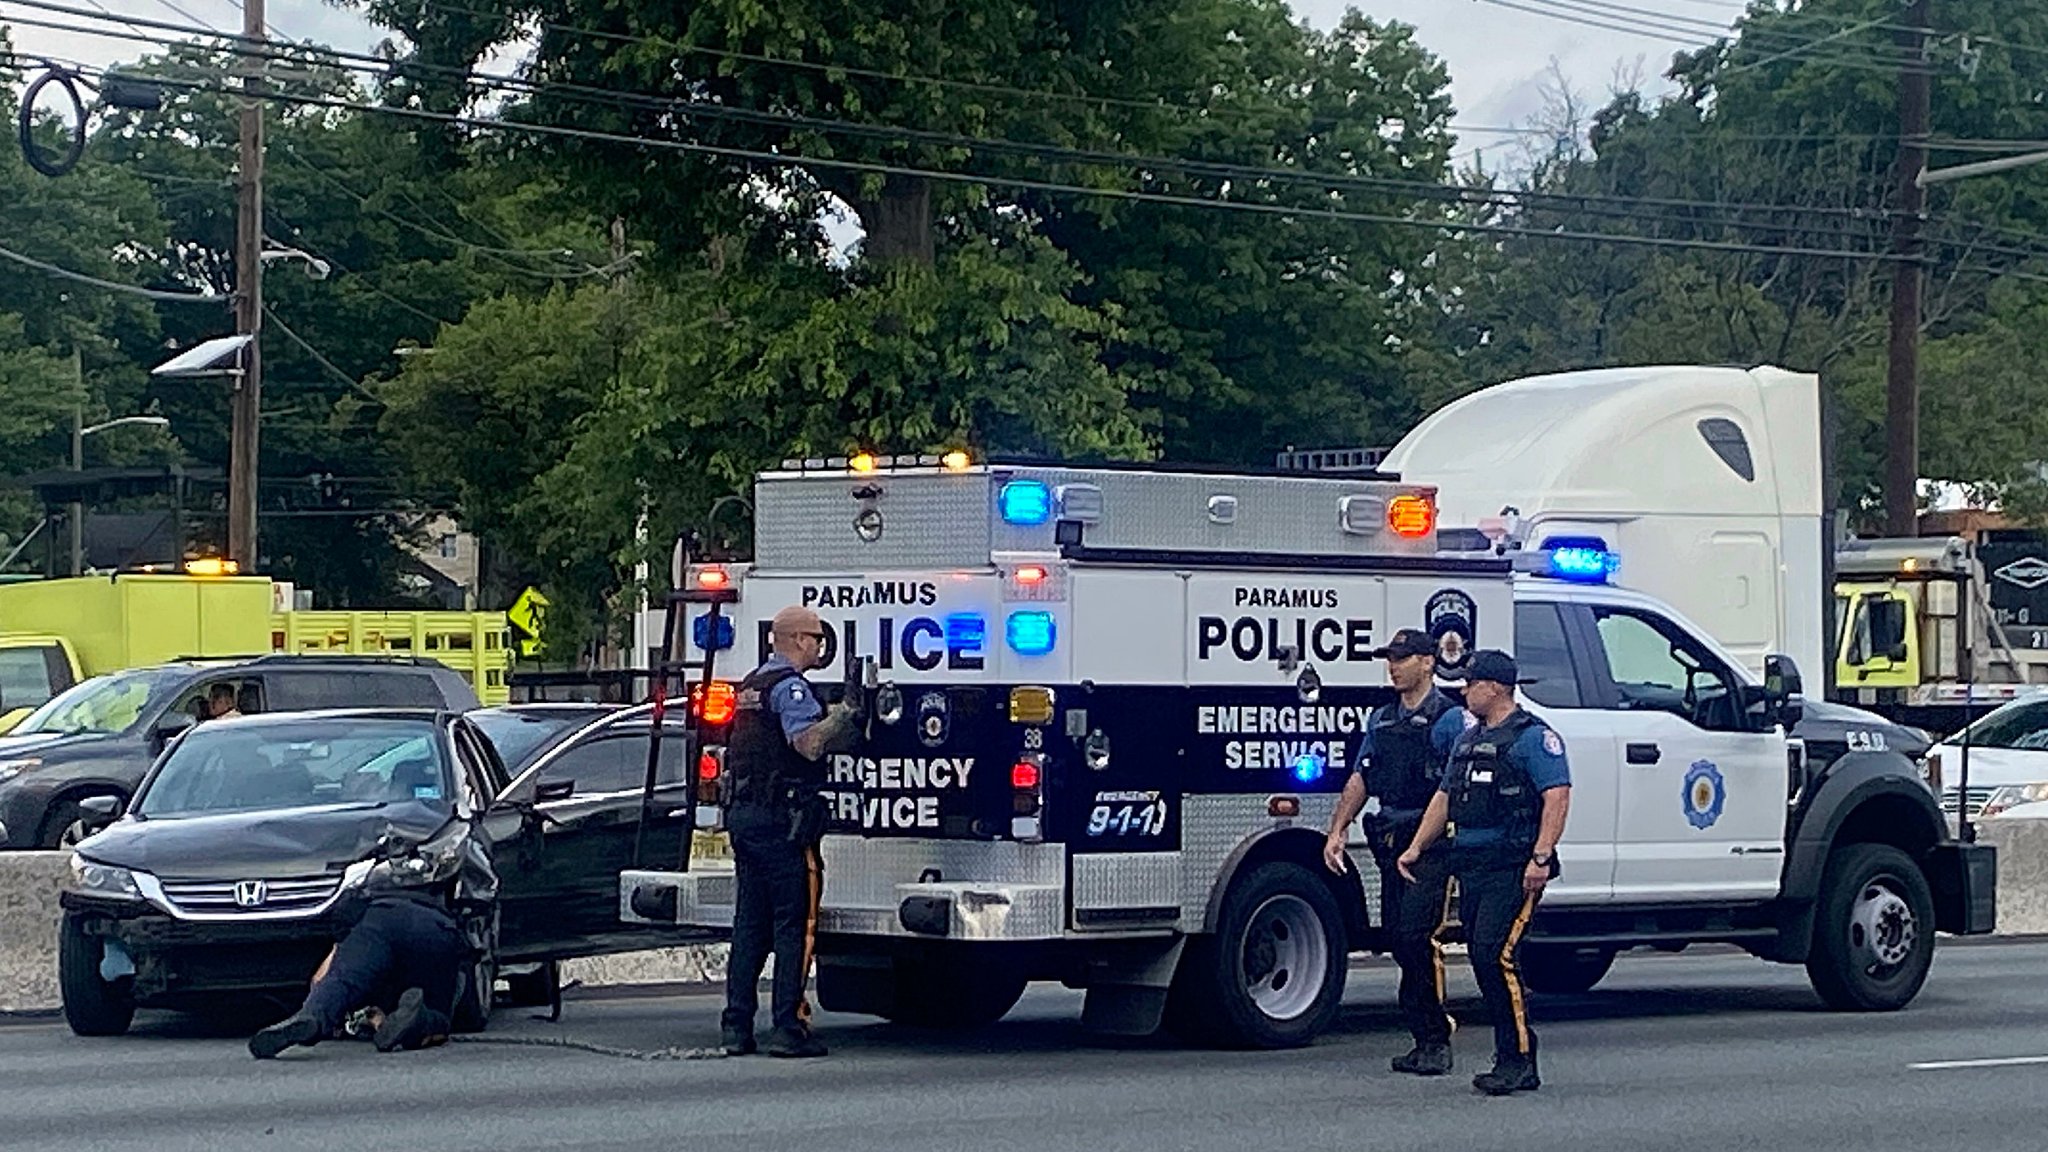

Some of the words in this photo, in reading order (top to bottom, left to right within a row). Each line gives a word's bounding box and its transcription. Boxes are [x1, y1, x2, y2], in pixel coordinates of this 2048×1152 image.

[803, 582, 936, 607] PARAMUS
[1235, 588, 1338, 608] PARAMUS
[1199, 616, 1373, 662] POLICE
[1198, 706, 1374, 733] EMERGENCY
[1225, 741, 1346, 769] SERVICE
[827, 754, 975, 788] RGENCY
[818, 791, 939, 828] RVICE
